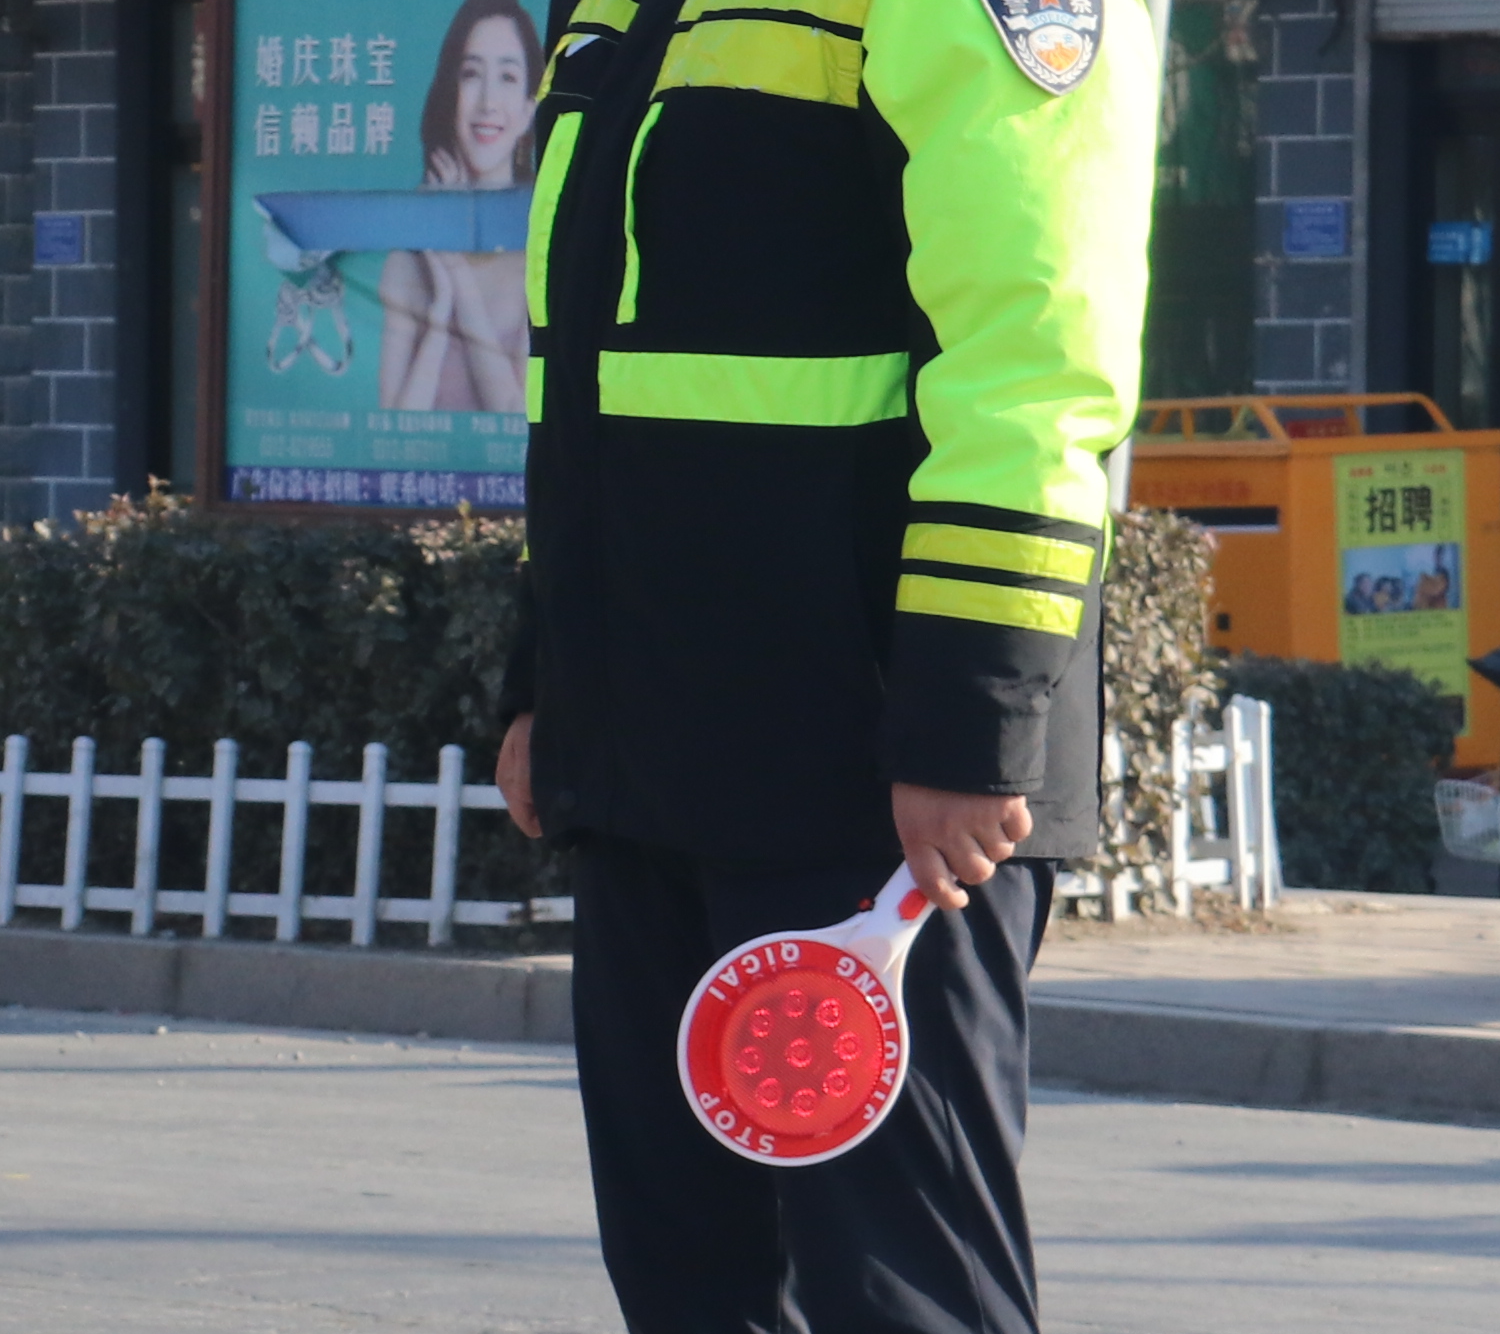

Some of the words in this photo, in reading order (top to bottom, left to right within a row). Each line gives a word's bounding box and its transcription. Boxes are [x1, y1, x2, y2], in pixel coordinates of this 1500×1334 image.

[255, 33, 397, 87] 婚庆珠宝
[254, 101, 395, 156] 信赖品牌
[1366, 484, 1433, 534] 招聘
[707, 941, 800, 1001] QICAI
[699, 1091, 775, 1155] STOP
